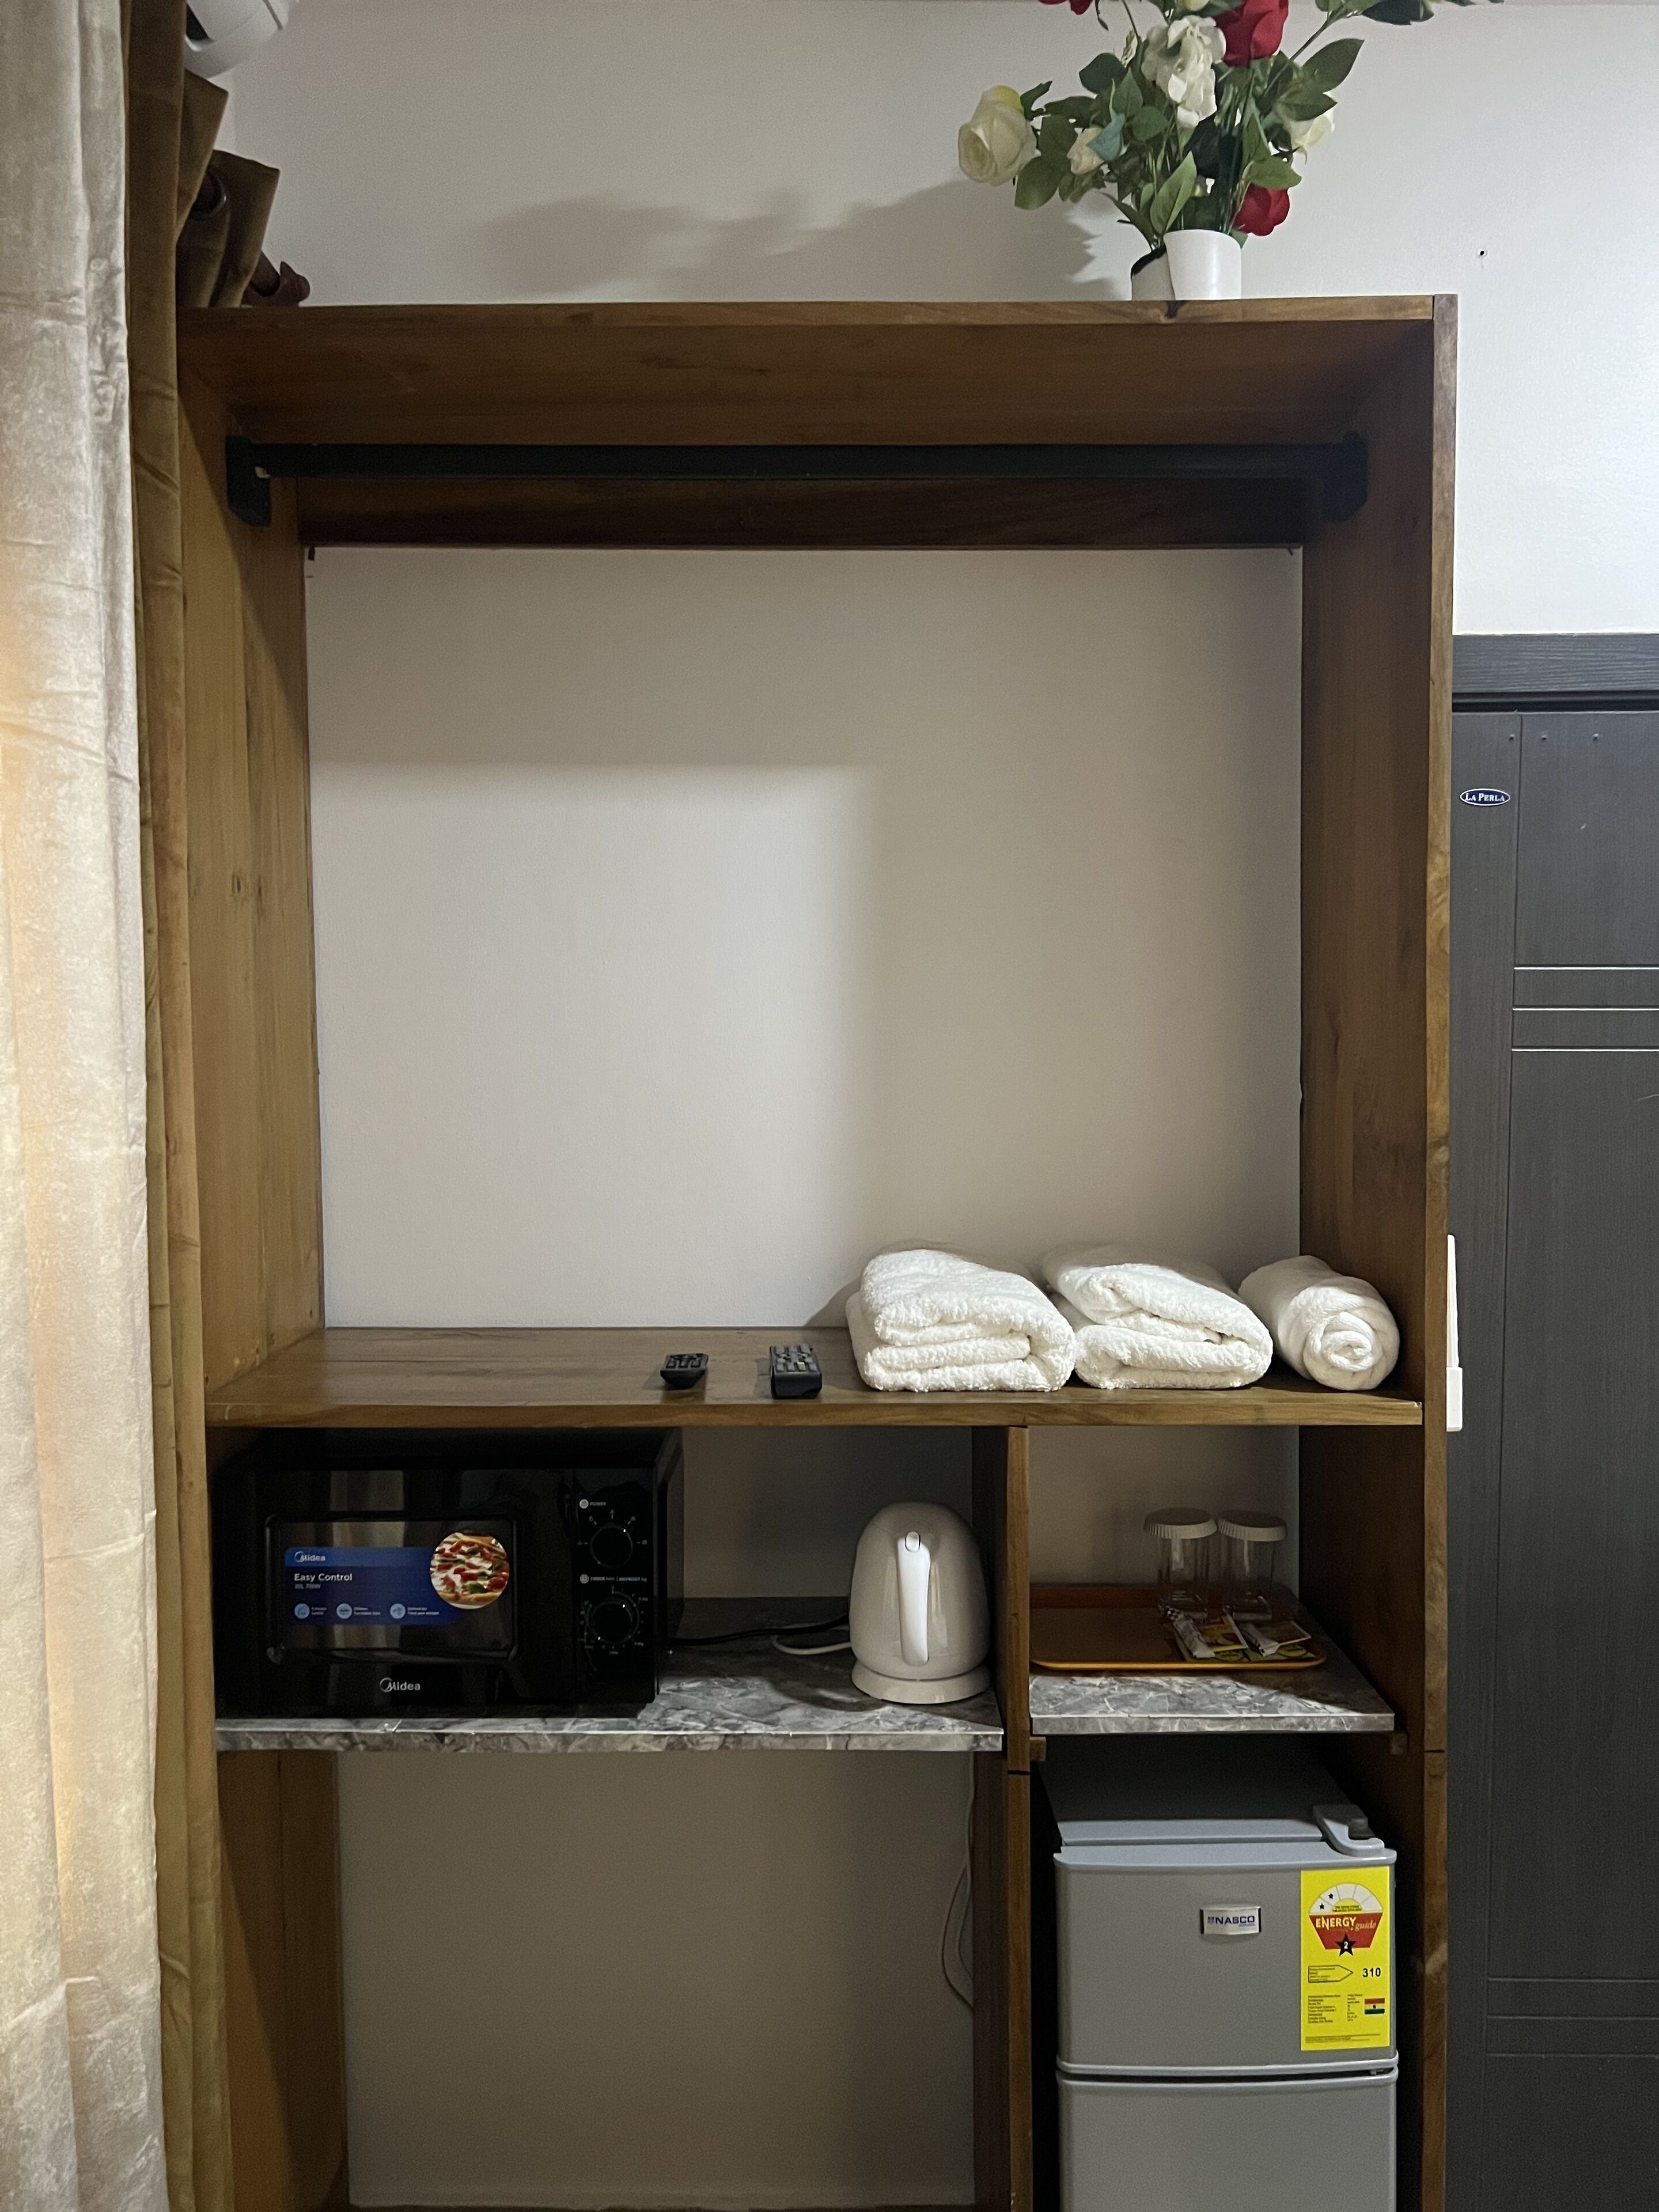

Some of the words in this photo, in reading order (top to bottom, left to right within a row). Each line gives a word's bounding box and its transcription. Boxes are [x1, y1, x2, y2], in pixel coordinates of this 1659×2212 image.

[1465, 793, 1476, 801] LA
[1478, 793, 1505, 802] PERLA
[294, 1551, 326, 1563] Midea
[294, 1573, 316, 1583] Easy
[318, 1573, 353, 1581] Control
[380, 1677, 421, 1693] Midea
[1215, 1915, 1255, 1925] NASCO
[1315, 1916, 1357, 1930] ENERGY
[1355, 1919, 1377, 1932] guide
[1343, 1941, 1349, 1949] 2
[1362, 1967, 1381, 1978] 310
